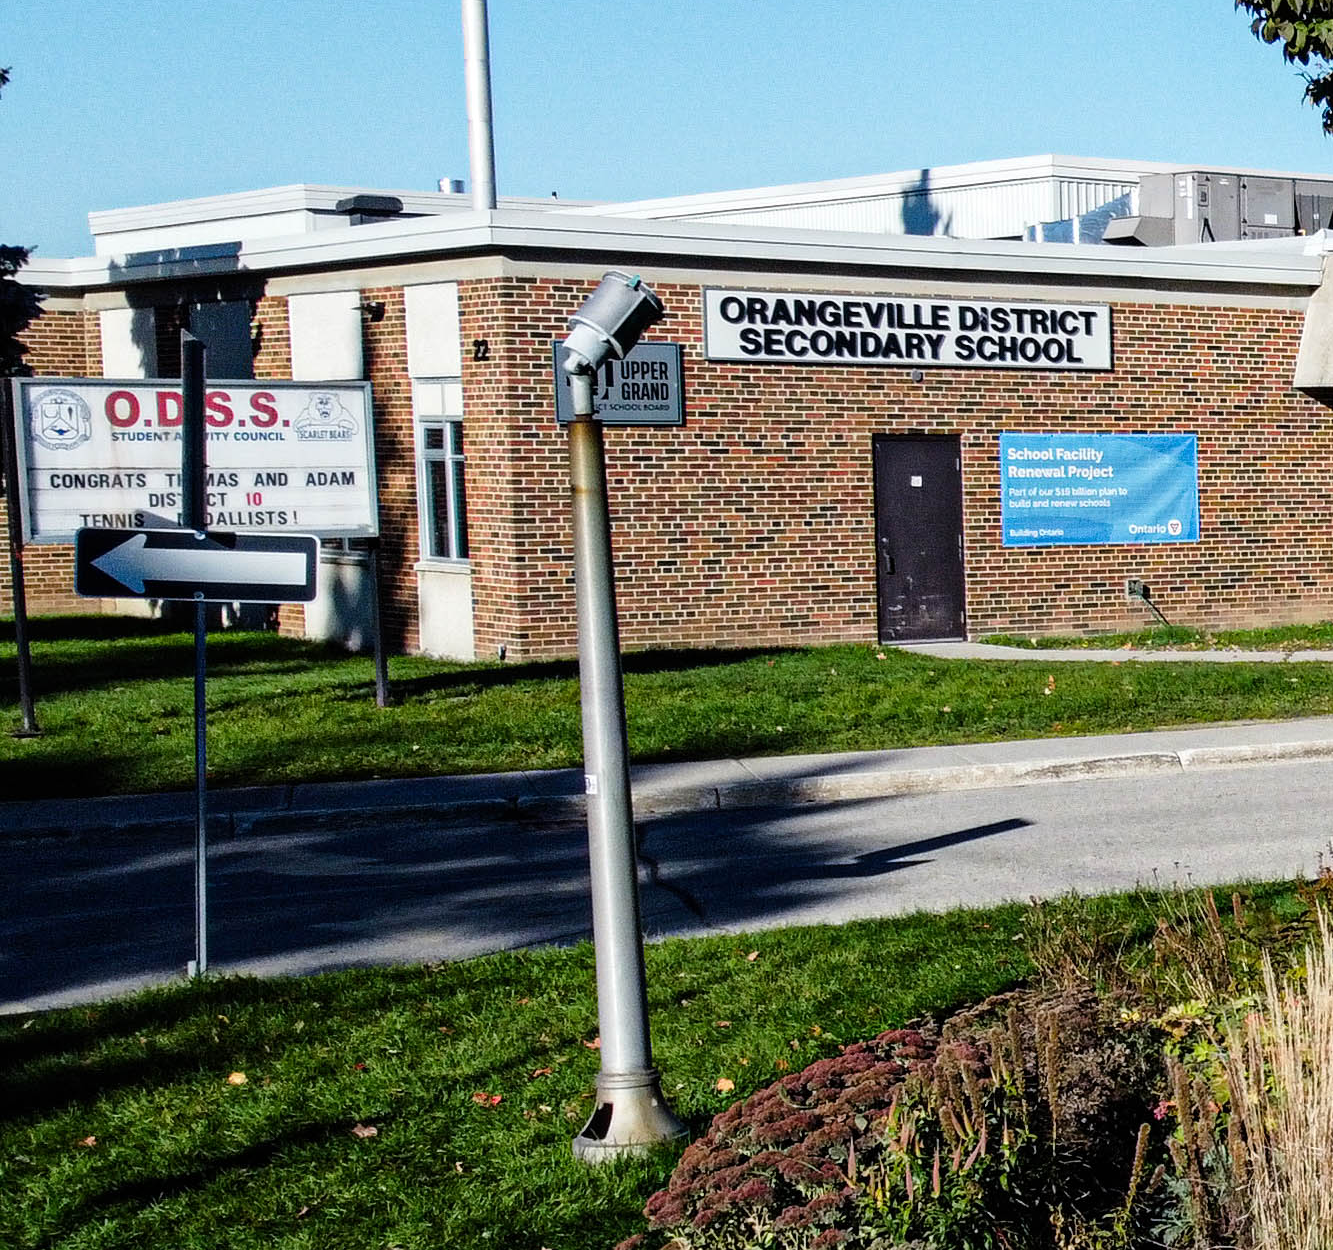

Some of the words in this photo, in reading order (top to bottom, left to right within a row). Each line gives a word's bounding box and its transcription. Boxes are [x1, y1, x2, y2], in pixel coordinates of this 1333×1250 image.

[719, 296, 951, 332] ORANGEVILLE
[959, 306, 1098, 337] DISTRICT
[739, 328, 946, 360] SECONDARY
[954, 335, 1083, 364] SCHOOL
[620, 361, 669, 380] UPPER
[621, 382, 669, 401] GRAND
[104, 390, 290, 428] O.DS.S.
[609, 403, 642, 412] SCHOOL
[643, 403, 671, 412] BOARD
[112, 431, 170, 442] STUDENT
[233, 431, 285, 441] COUNCIL
[300, 430, 328, 439] SCARLET
[1007, 447, 1054, 461] School
[1055, 447, 1104, 463] Facility
[1008, 465, 1066, 478] Renewal
[1068, 465, 1114, 480] Project
[50, 473, 147, 489] CONGRATS
[165, 473, 239, 488] TMAS
[254, 472, 288, 487] AND
[306, 472, 355, 486] ADAM
[1009, 487, 1026, 497] Part
[1028, 487, 1037, 496] of
[1039, 488, 1054, 496] our
[1072, 487, 1098, 496] billion
[1099, 487, 1118, 498] plan
[1118, 486, 1128, 496] to
[149, 492, 227, 508] DISCT
[245, 492, 263, 506] 10
[1009, 499, 1031, 508] build
[1032, 499, 1049, 508] and
[1079, 499, 1111, 508] schools
[79, 513, 145, 528] TENNIS
[1009, 529, 1039, 538] Building
[1039, 528, 1064, 537] Ontario
[1128, 523, 1167, 534] Ontario
